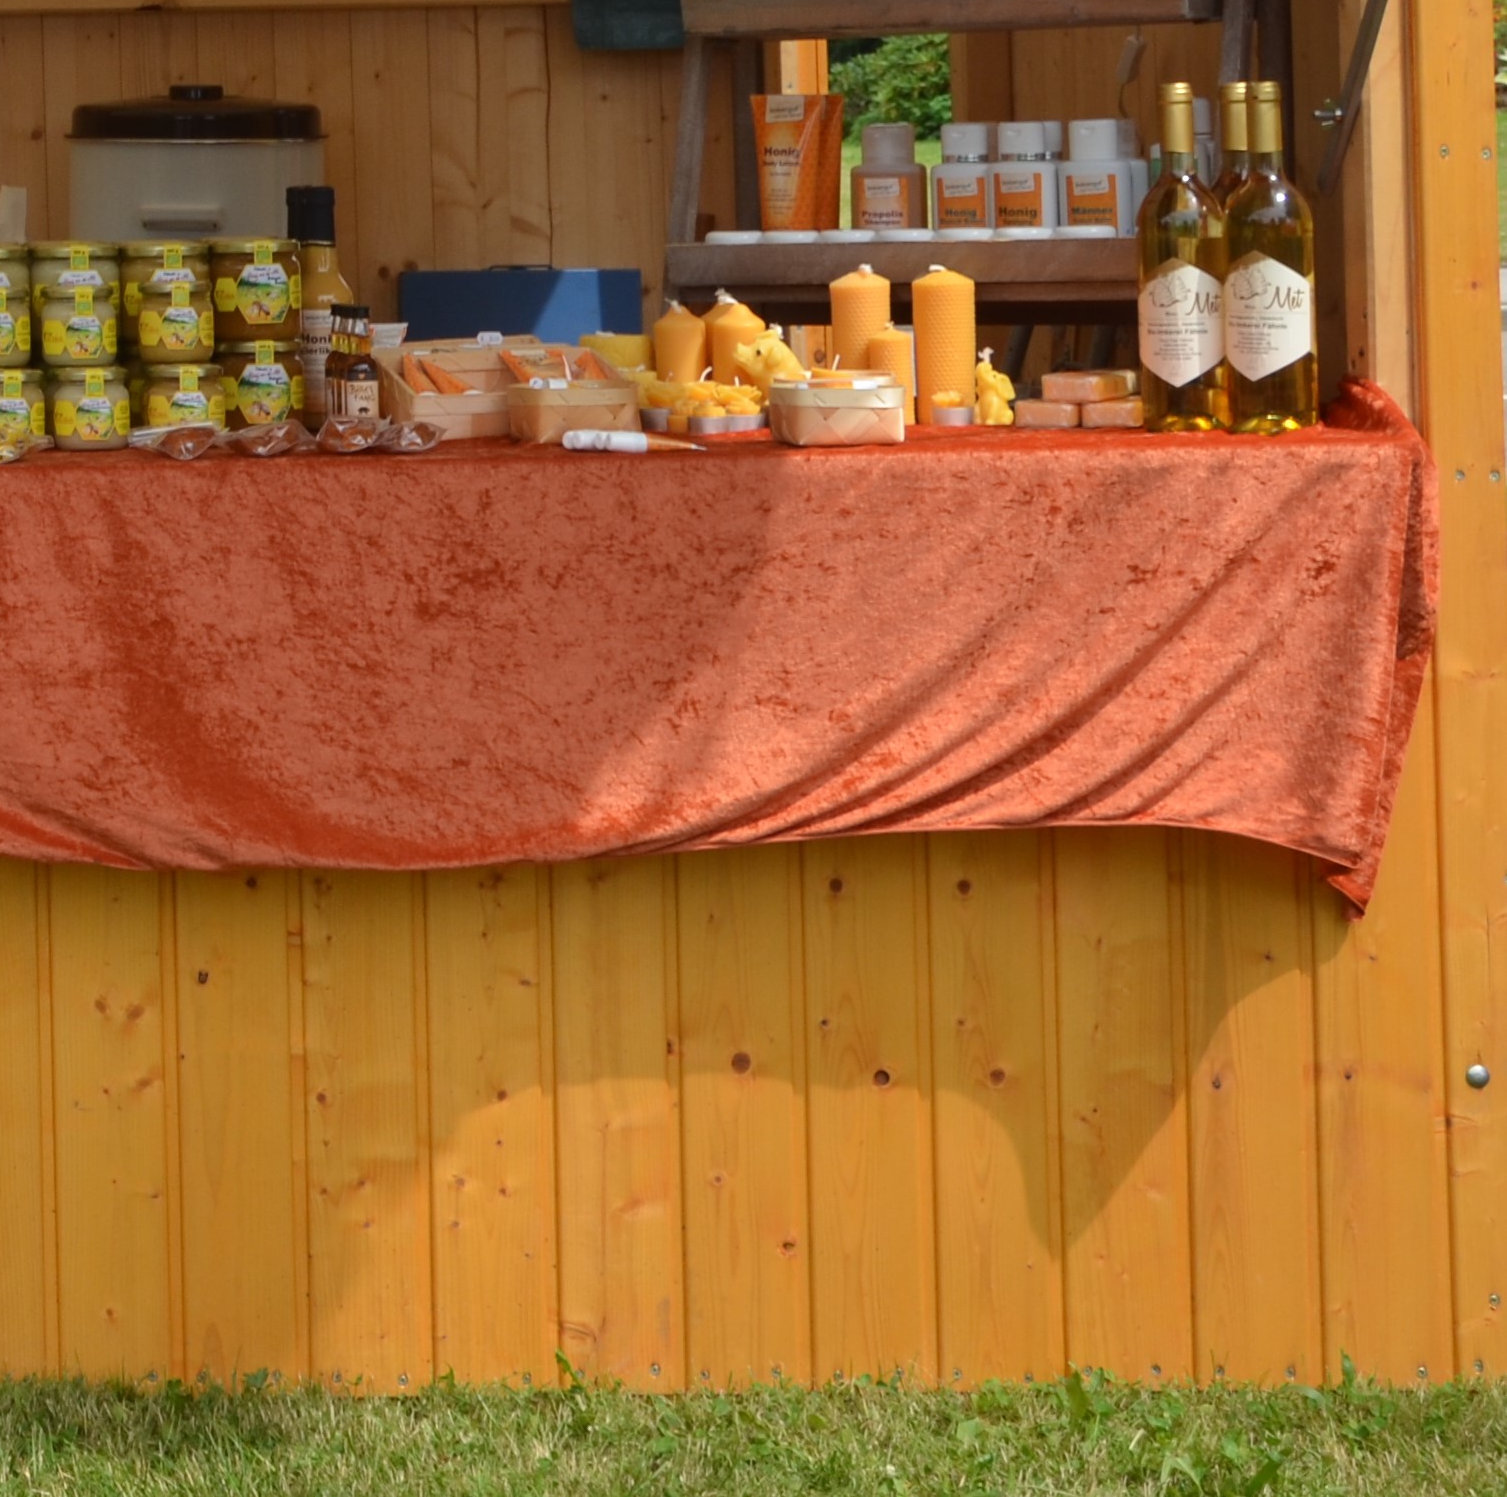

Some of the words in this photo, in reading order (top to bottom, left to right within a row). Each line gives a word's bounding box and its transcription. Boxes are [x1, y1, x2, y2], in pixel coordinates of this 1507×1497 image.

[763, 146, 800, 159] Honig
[862, 210, 904, 220] Propolis
[945, 207, 977, 218] Honig
[998, 206, 1038, 219] Honig
[1185, 291, 1222, 316] Met
[1264, 286, 1305, 311] Met
[301, 334, 331, 345] Honi
